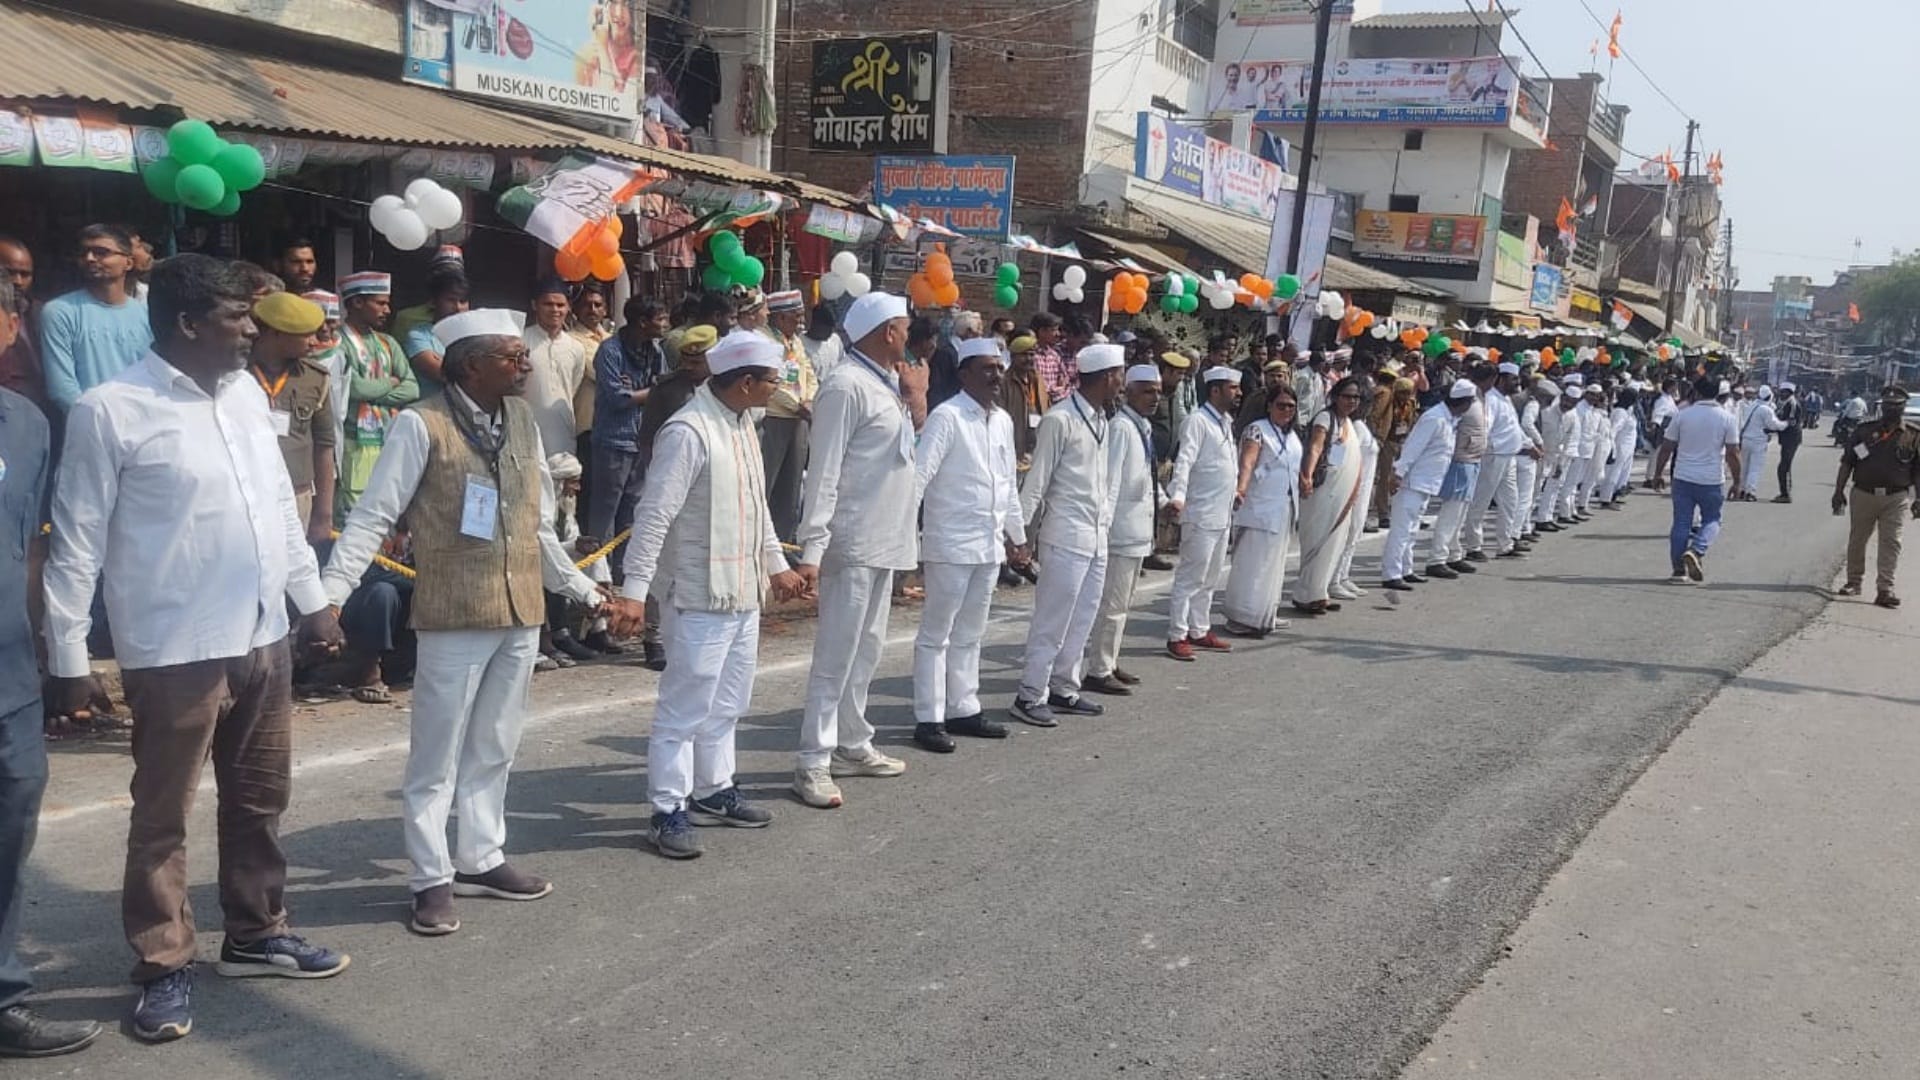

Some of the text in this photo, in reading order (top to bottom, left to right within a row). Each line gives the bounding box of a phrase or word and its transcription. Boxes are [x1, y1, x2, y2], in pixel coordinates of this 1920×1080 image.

[477, 73, 621, 112] MUSKAN COSMETIC
[842, 41, 905, 112] श्री
[814, 104, 929, 149] मोबाइल शॉप
